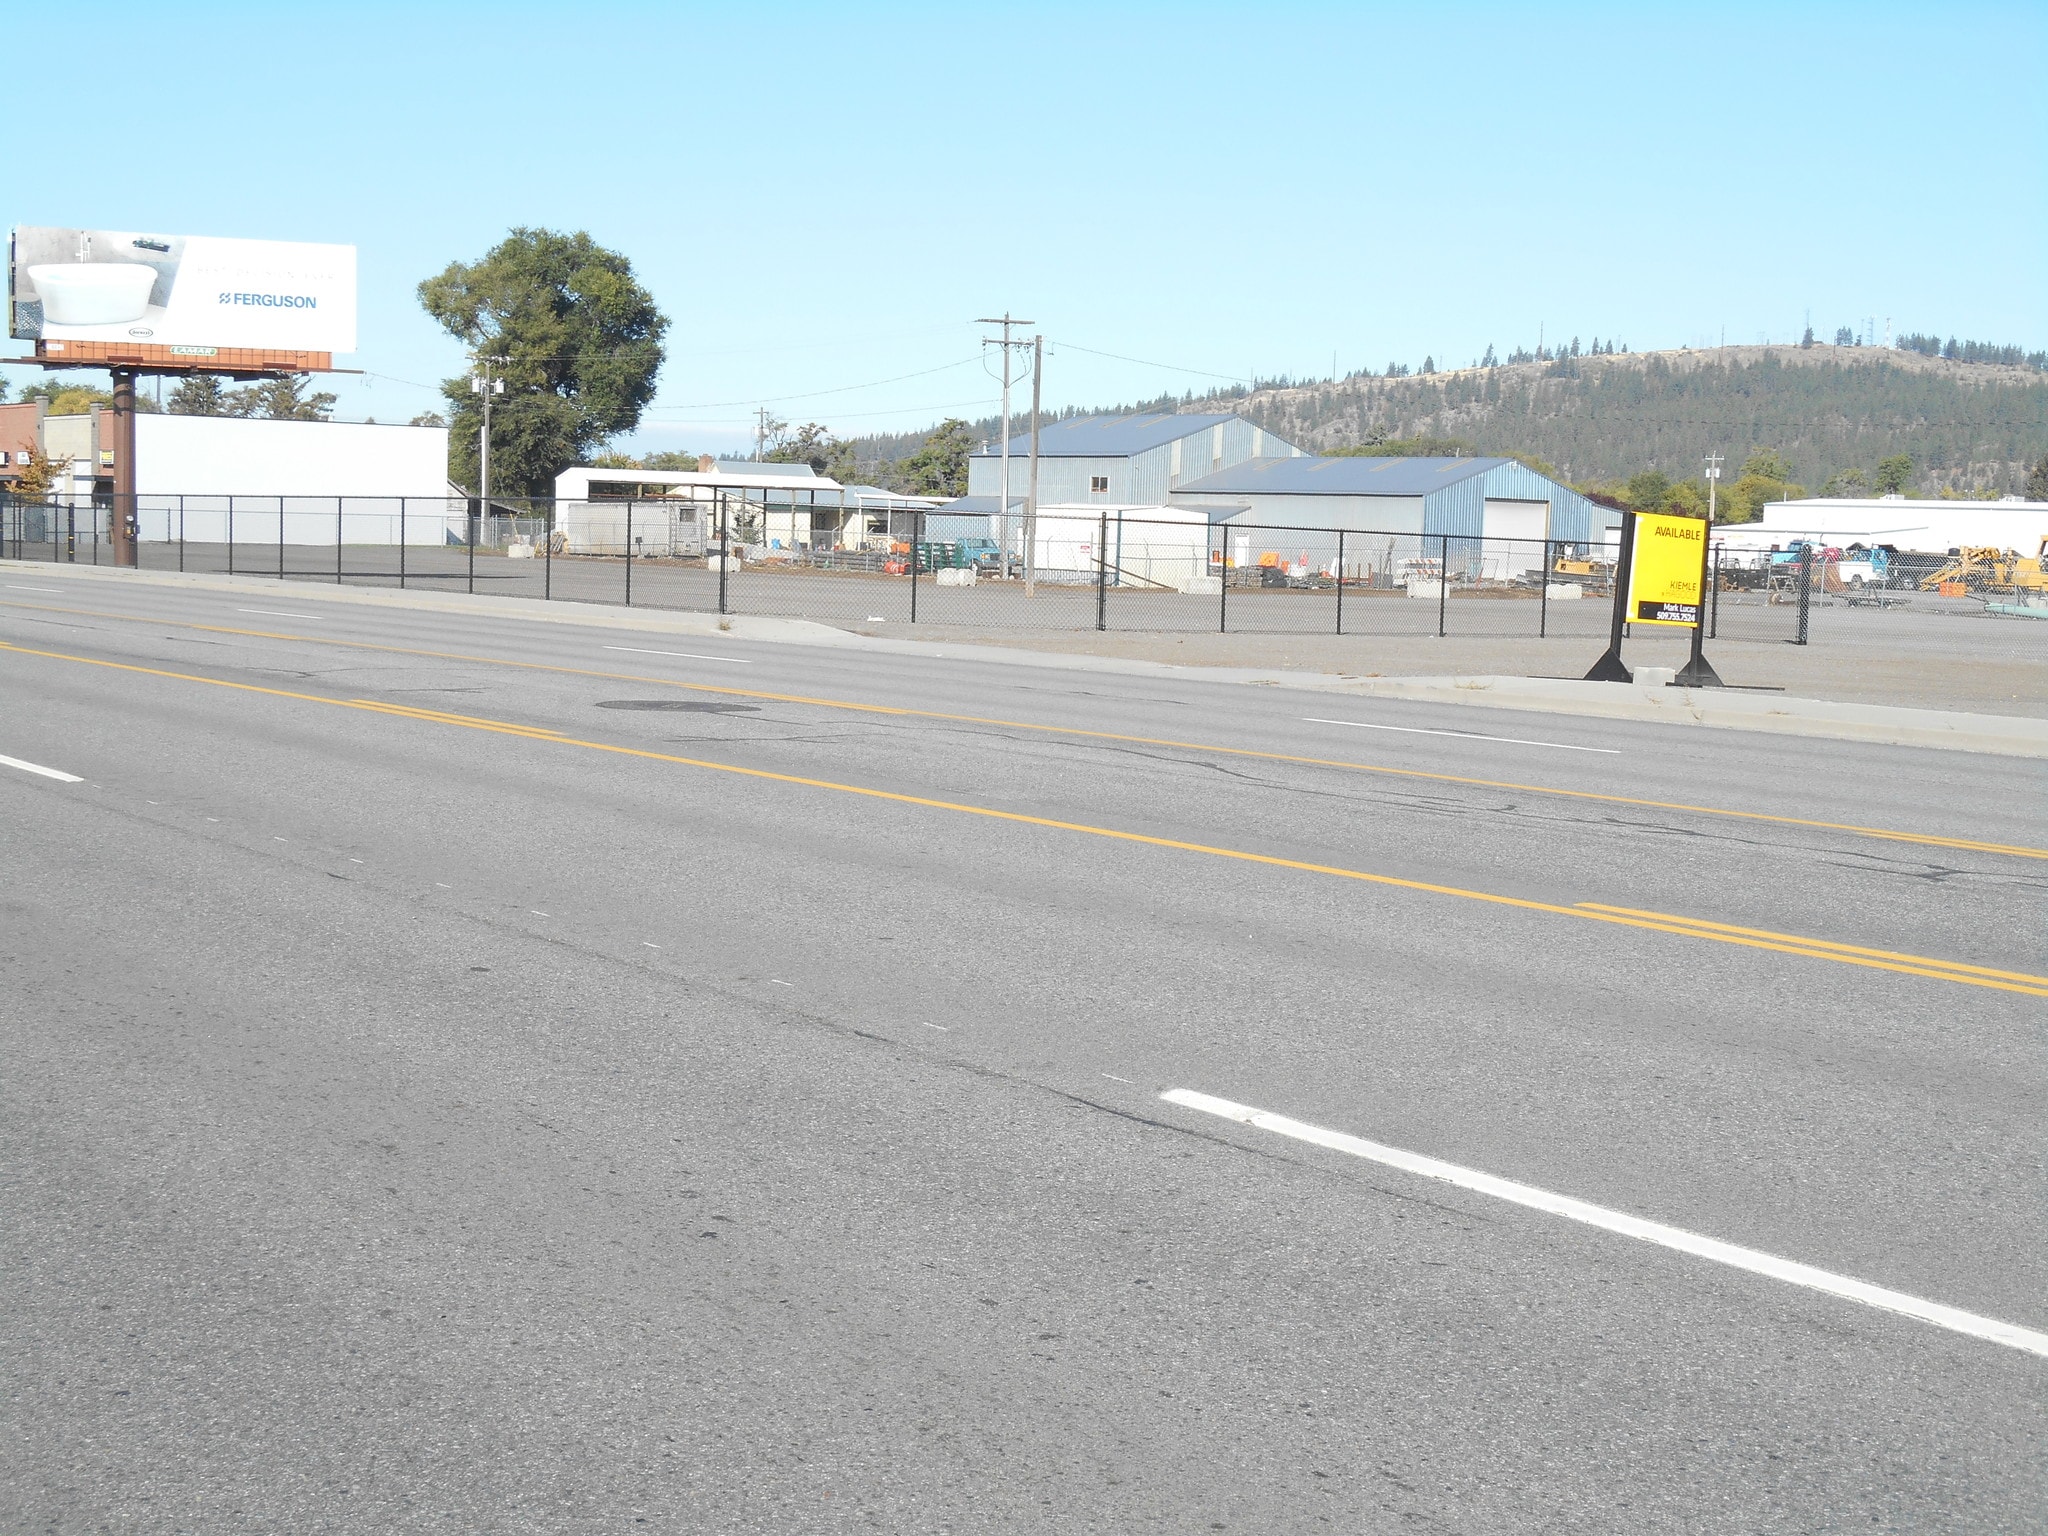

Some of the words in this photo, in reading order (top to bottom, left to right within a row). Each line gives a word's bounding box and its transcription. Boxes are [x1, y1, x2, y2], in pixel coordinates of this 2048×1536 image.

[234, 293, 317, 309] FERGUSON
[1655, 526, 1701, 541] AVAILABLE
[1670, 580, 1697, 591] KIEMLE
[1663, 603, 1679, 612] Mark
[1680, 604, 1697, 613] Lucas
